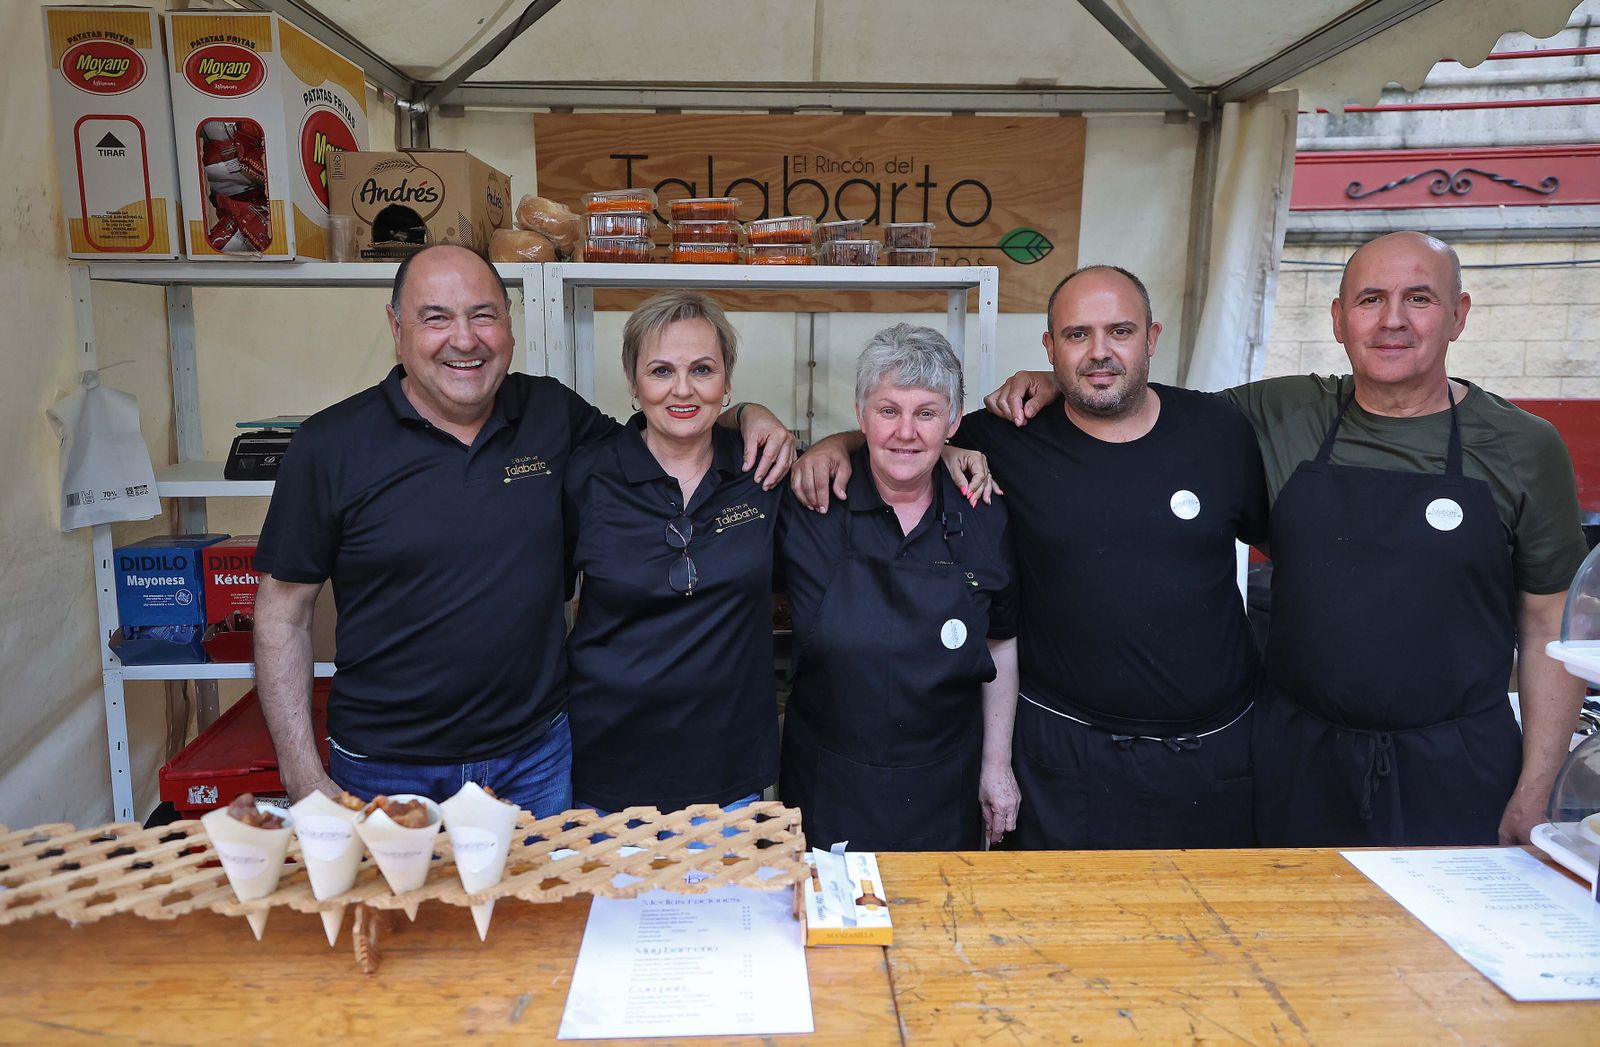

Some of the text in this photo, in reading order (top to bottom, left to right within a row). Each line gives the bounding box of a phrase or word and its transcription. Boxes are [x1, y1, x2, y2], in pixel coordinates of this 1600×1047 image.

[67, 31, 134, 45] PATATAS FRITAS
[190, 35, 256, 49] PATATAS FRITAS
[76, 54, 131, 75] Moyano
[199, 58, 252, 78] Moyano
[303, 88, 356, 128] PATATAS FRITAS
[97, 149, 126, 157] TIRAR
[793, 155, 914, 174] El Rincón del
[360, 178, 439, 205] Andrés
[609, 154, 993, 228] Talabarto
[504, 461, 546, 477] Talabarto
[102, 490, 117, 498] 70%
[715, 507, 759, 527] Talabarto
[121, 556, 188, 571] DIDILO
[208, 556, 251, 570] DIDI
[126, 575, 185, 588] Mayonesa
[214, 573, 260, 585] Kétchu
